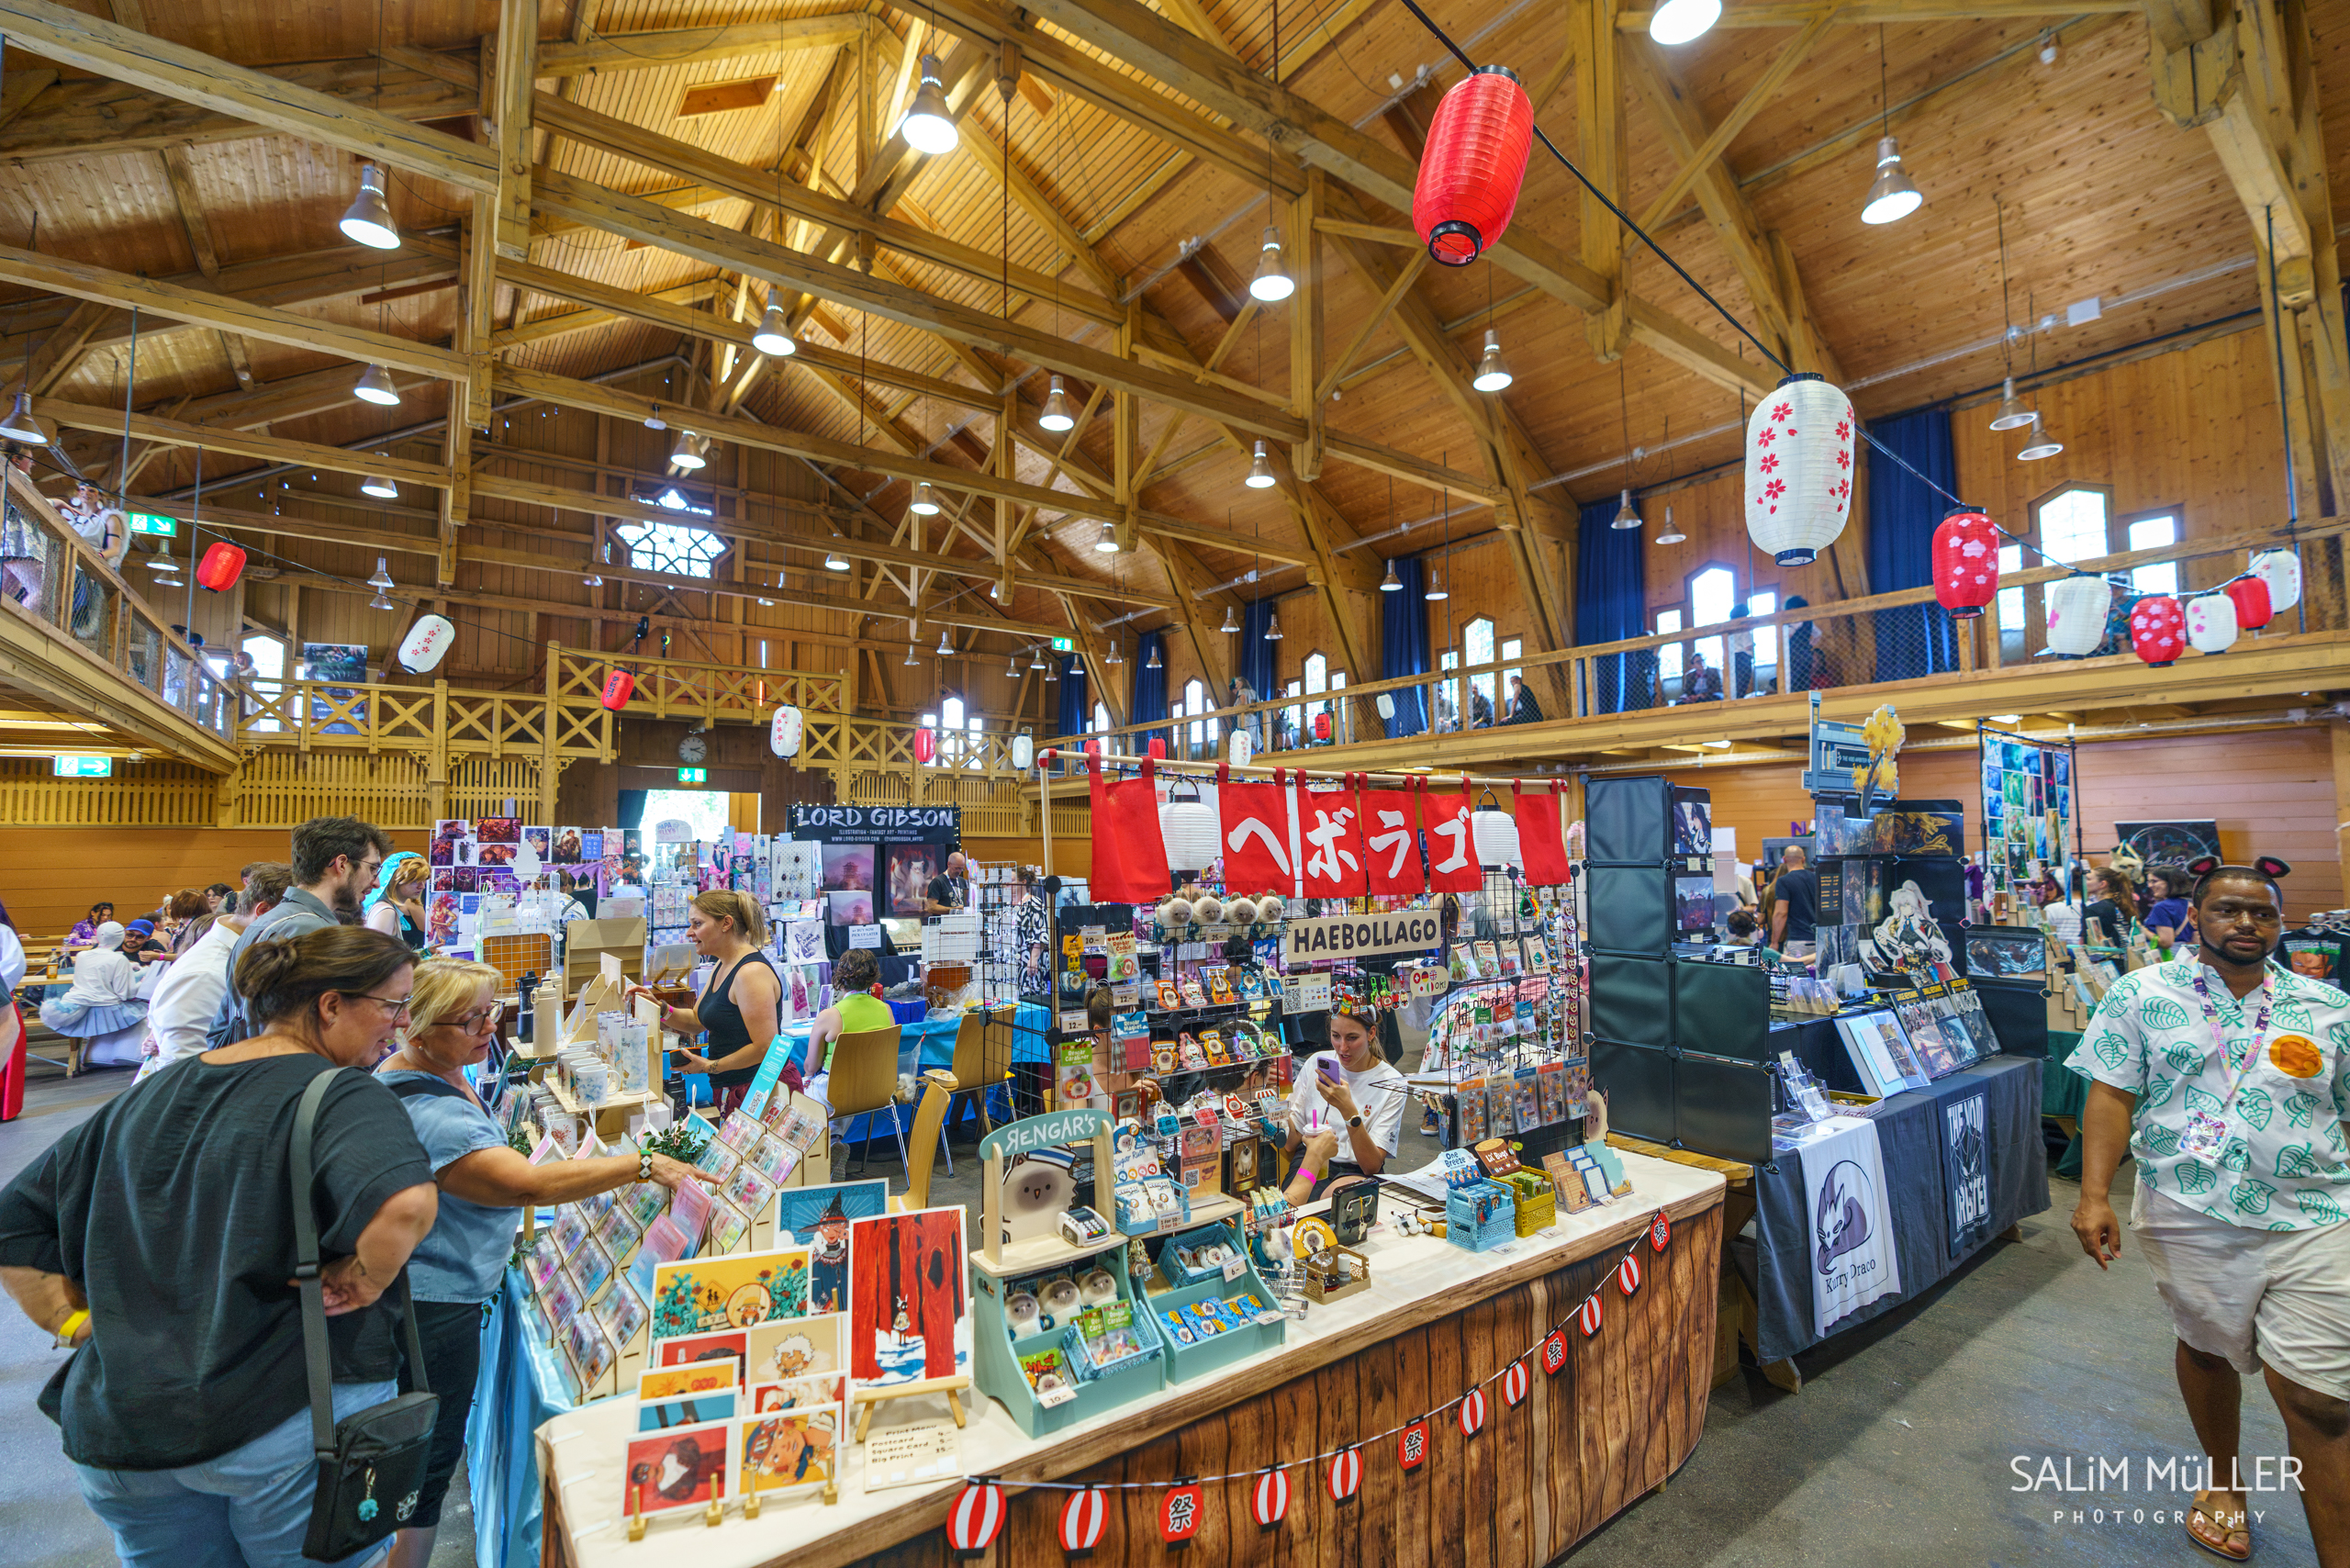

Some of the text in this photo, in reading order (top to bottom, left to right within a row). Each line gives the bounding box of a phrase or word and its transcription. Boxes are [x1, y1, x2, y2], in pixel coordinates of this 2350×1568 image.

[797, 808, 953, 827] LORD GIBSON
[1227, 805, 1472, 883] ヘボラゴ
[1294, 919, 1437, 953] HAEBOLLAGO
[2210, 1022, 2227, 1059] Chibi-Con
[2244, 1036, 2263, 1070] Chibi-Con
[1948, 1095, 1984, 1147] THE VOID
[1005, 1114, 1096, 1152] RENGAR'S
[1114, 1149, 1146, 1168] Sugar Rush
[1445, 1158, 1467, 1168] Breeze
[1446, 1151, 1459, 1160] One
[1485, 1149, 1509, 1163] Lil' Bugs
[1294, 1221, 1326, 1240] Stamp Station
[1652, 1219, 1668, 1247] 祭
[1825, 1259, 1876, 1294] Kurry Draco
[1107, 1315, 1129, 1326] Carabiner
[1547, 1337, 1563, 1368] 祭
[1048, 1394, 1068, 1404] 10.-
[872, 1437, 914, 1447] Postcard
[886, 1428, 909, 1437] Print
[872, 1446, 903, 1456] Square
[907, 1441, 929, 1450] Card
[1404, 1428, 1424, 1462] 祭
[889, 1452, 913, 1462] Print
[1168, 1493, 1196, 1533] 祭
